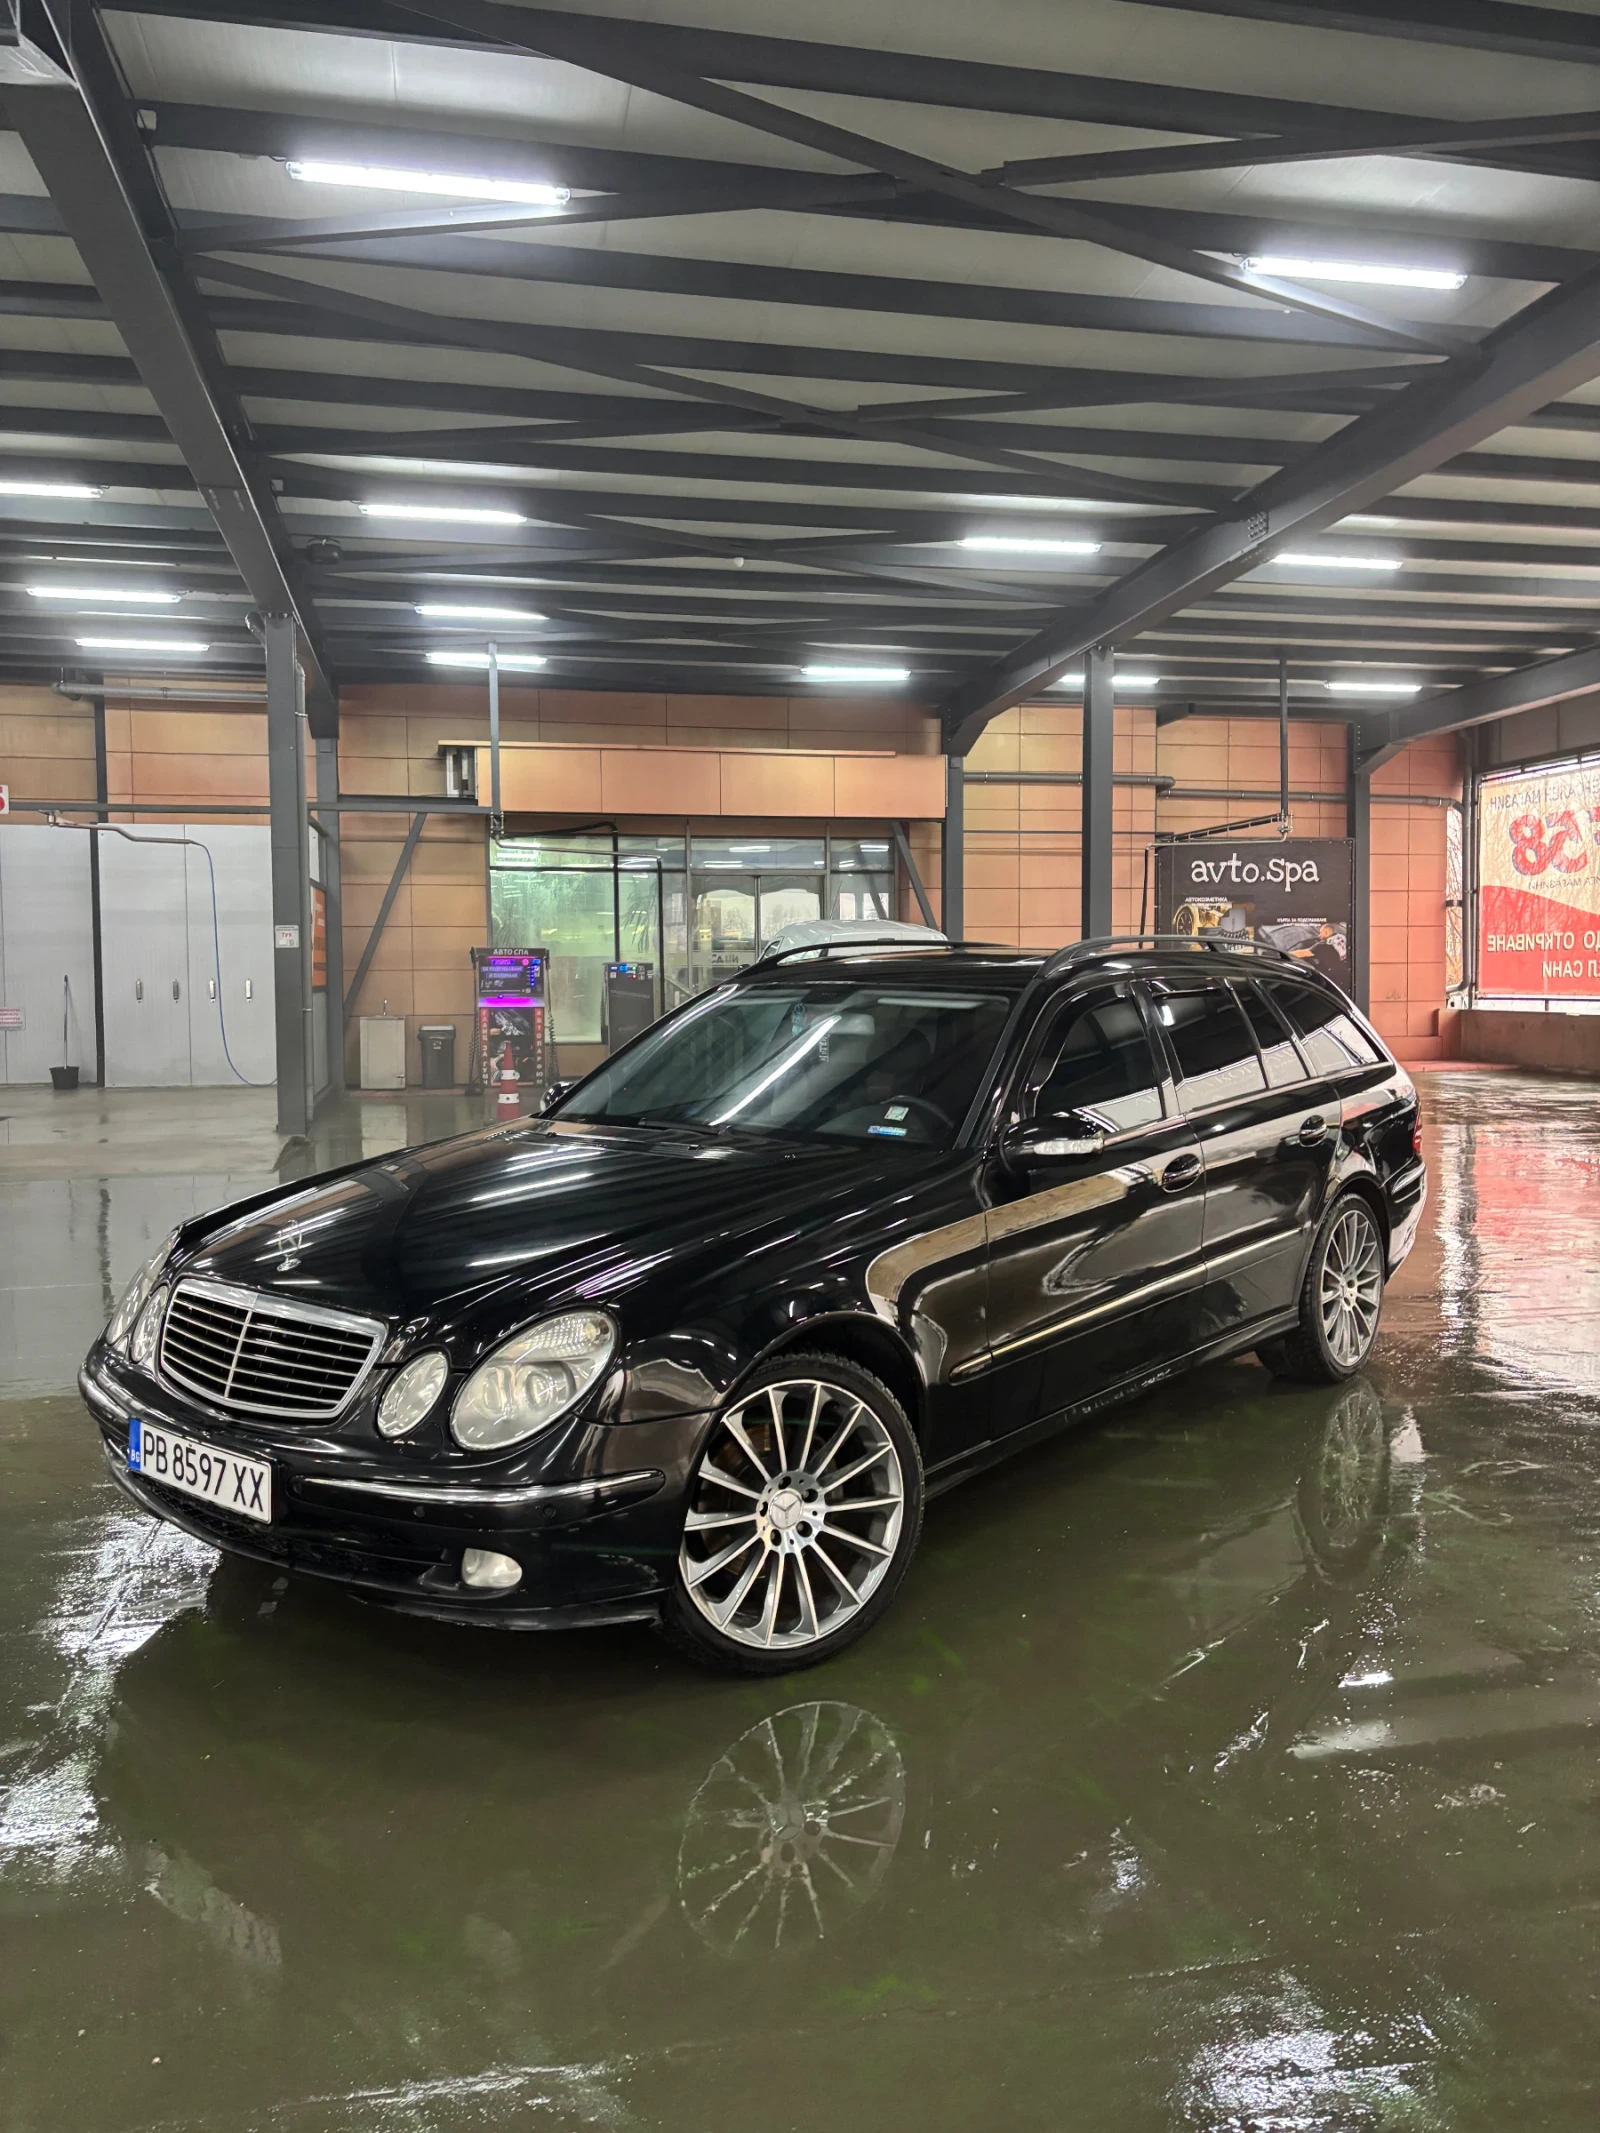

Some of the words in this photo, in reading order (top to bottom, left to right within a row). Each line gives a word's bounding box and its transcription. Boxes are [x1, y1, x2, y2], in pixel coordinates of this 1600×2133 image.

[1191, 853, 1319, 892] avto.spa
[131, 1449, 141, 1464] BG
[143, 1430, 168, 1475] PB
[172, 1443, 227, 1496] 8597
[233, 1462, 265, 1513] XX
